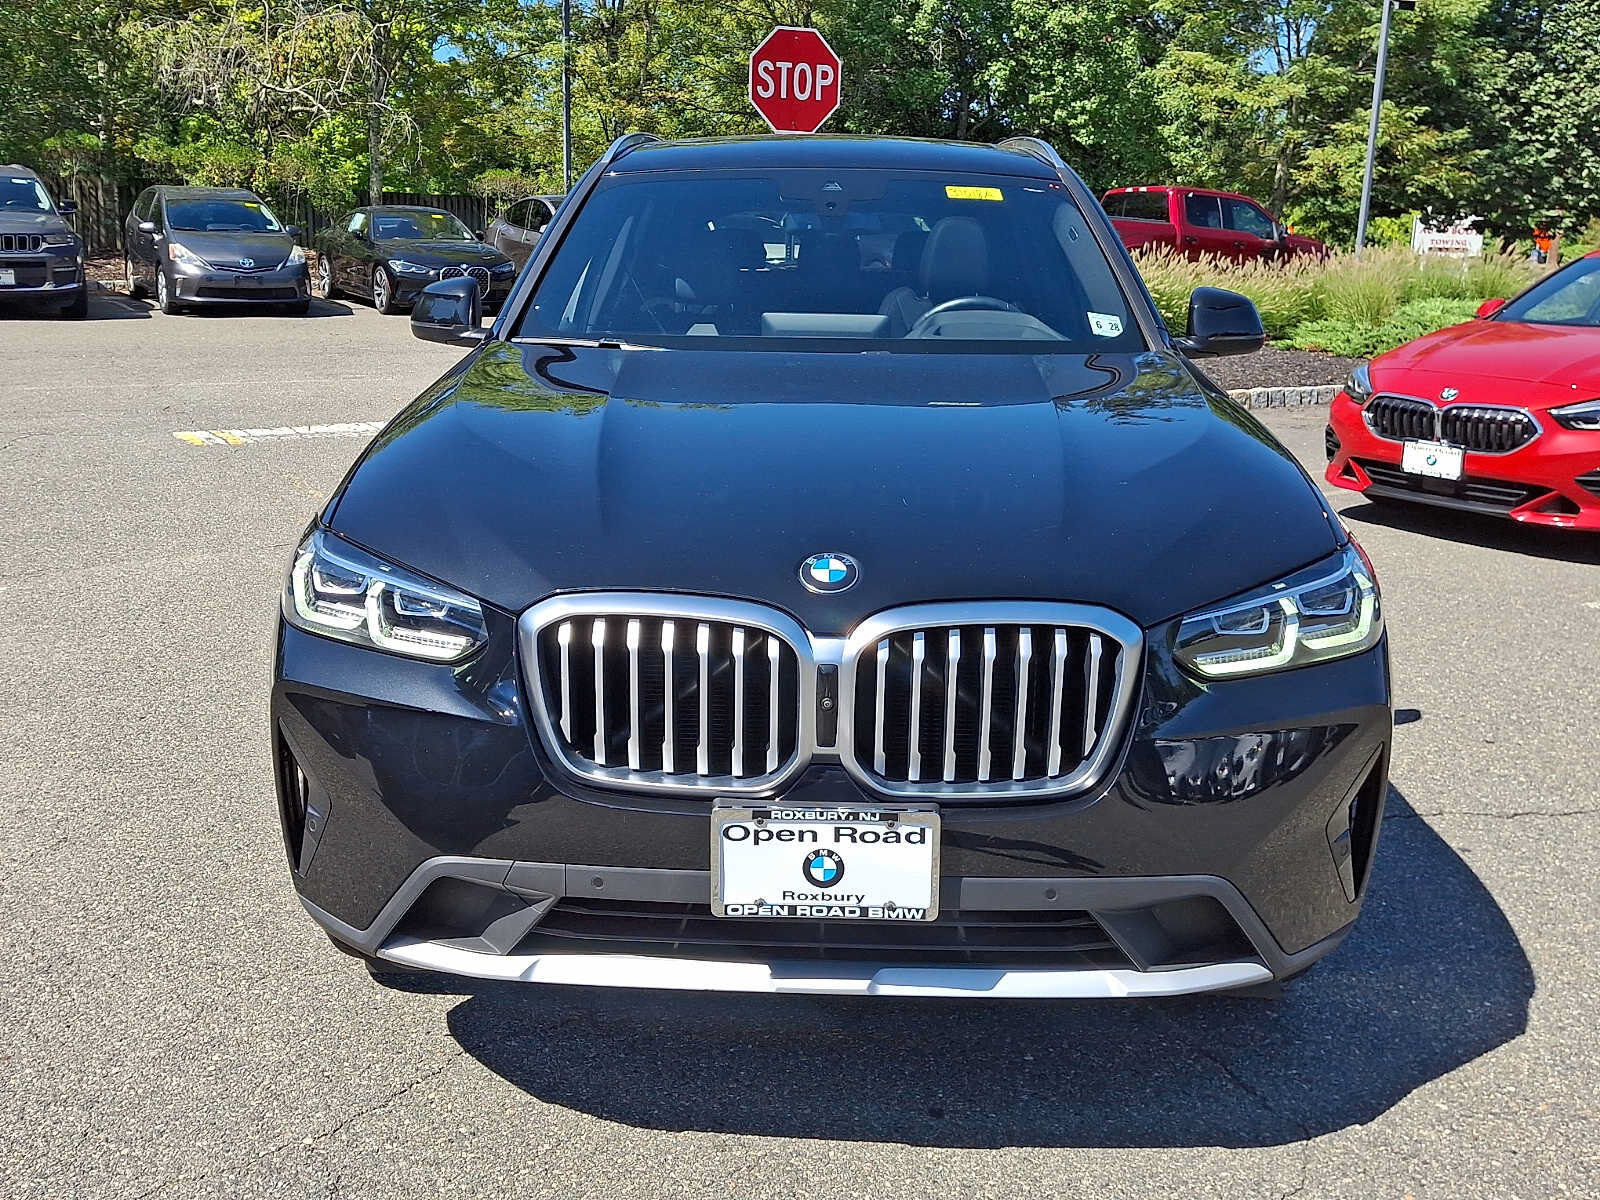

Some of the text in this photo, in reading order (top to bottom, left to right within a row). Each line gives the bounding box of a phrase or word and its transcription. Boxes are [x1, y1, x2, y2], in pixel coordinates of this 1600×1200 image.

[756, 59, 835, 101] STOP
[1430, 238, 1468, 246] TOWING
[1096, 321, 1120, 331] 6 28
[806, 552, 853, 566] BMW
[770, 809, 880, 822] ROXBURY, NJ
[722, 824, 926, 846] Open Road
[807, 849, 842, 863] BMW
[782, 890, 866, 905] Roxbury
[726, 904, 924, 920] OPEN ROAD BMW
